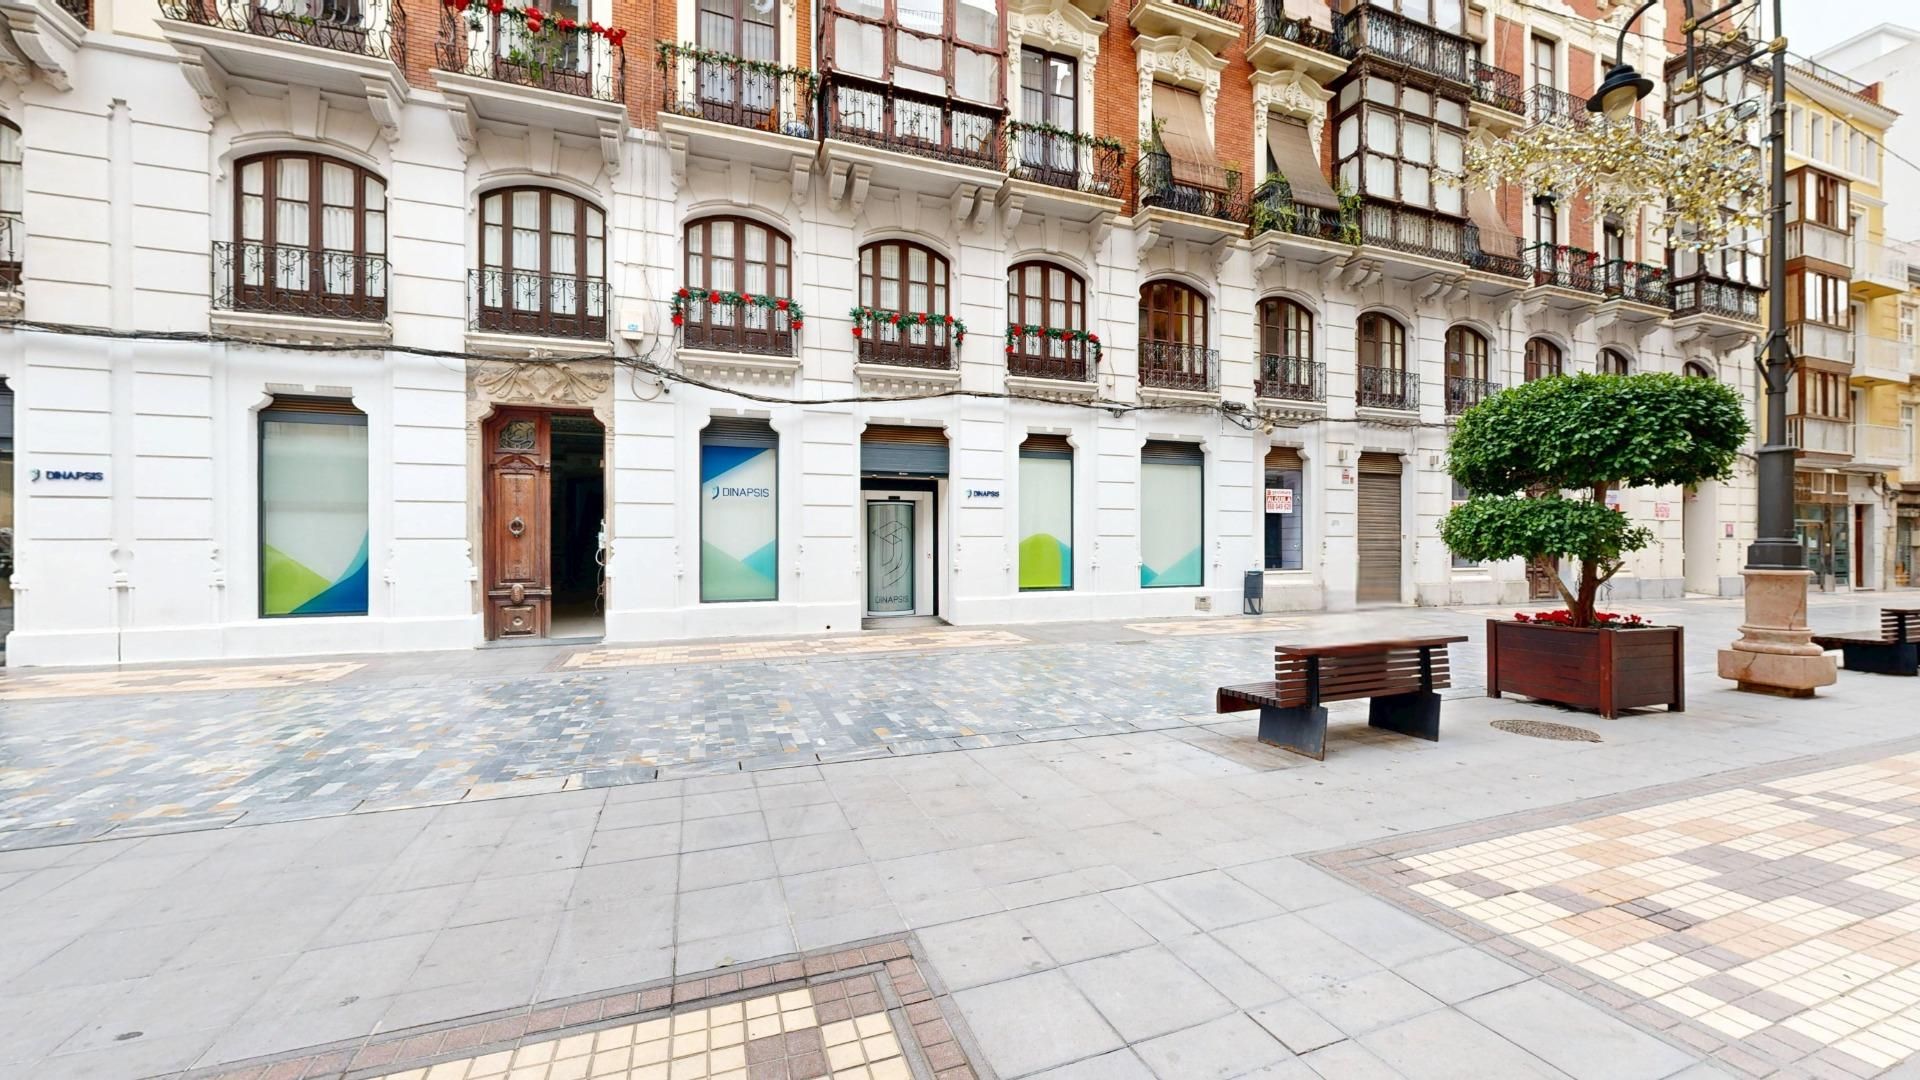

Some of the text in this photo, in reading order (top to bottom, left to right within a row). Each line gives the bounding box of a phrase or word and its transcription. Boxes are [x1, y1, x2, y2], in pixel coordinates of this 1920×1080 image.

[46, 470, 104, 480] DINAPSIS
[722, 488, 770, 498] DINAPSIS
[874, 595, 909, 604] DINAPSIS
